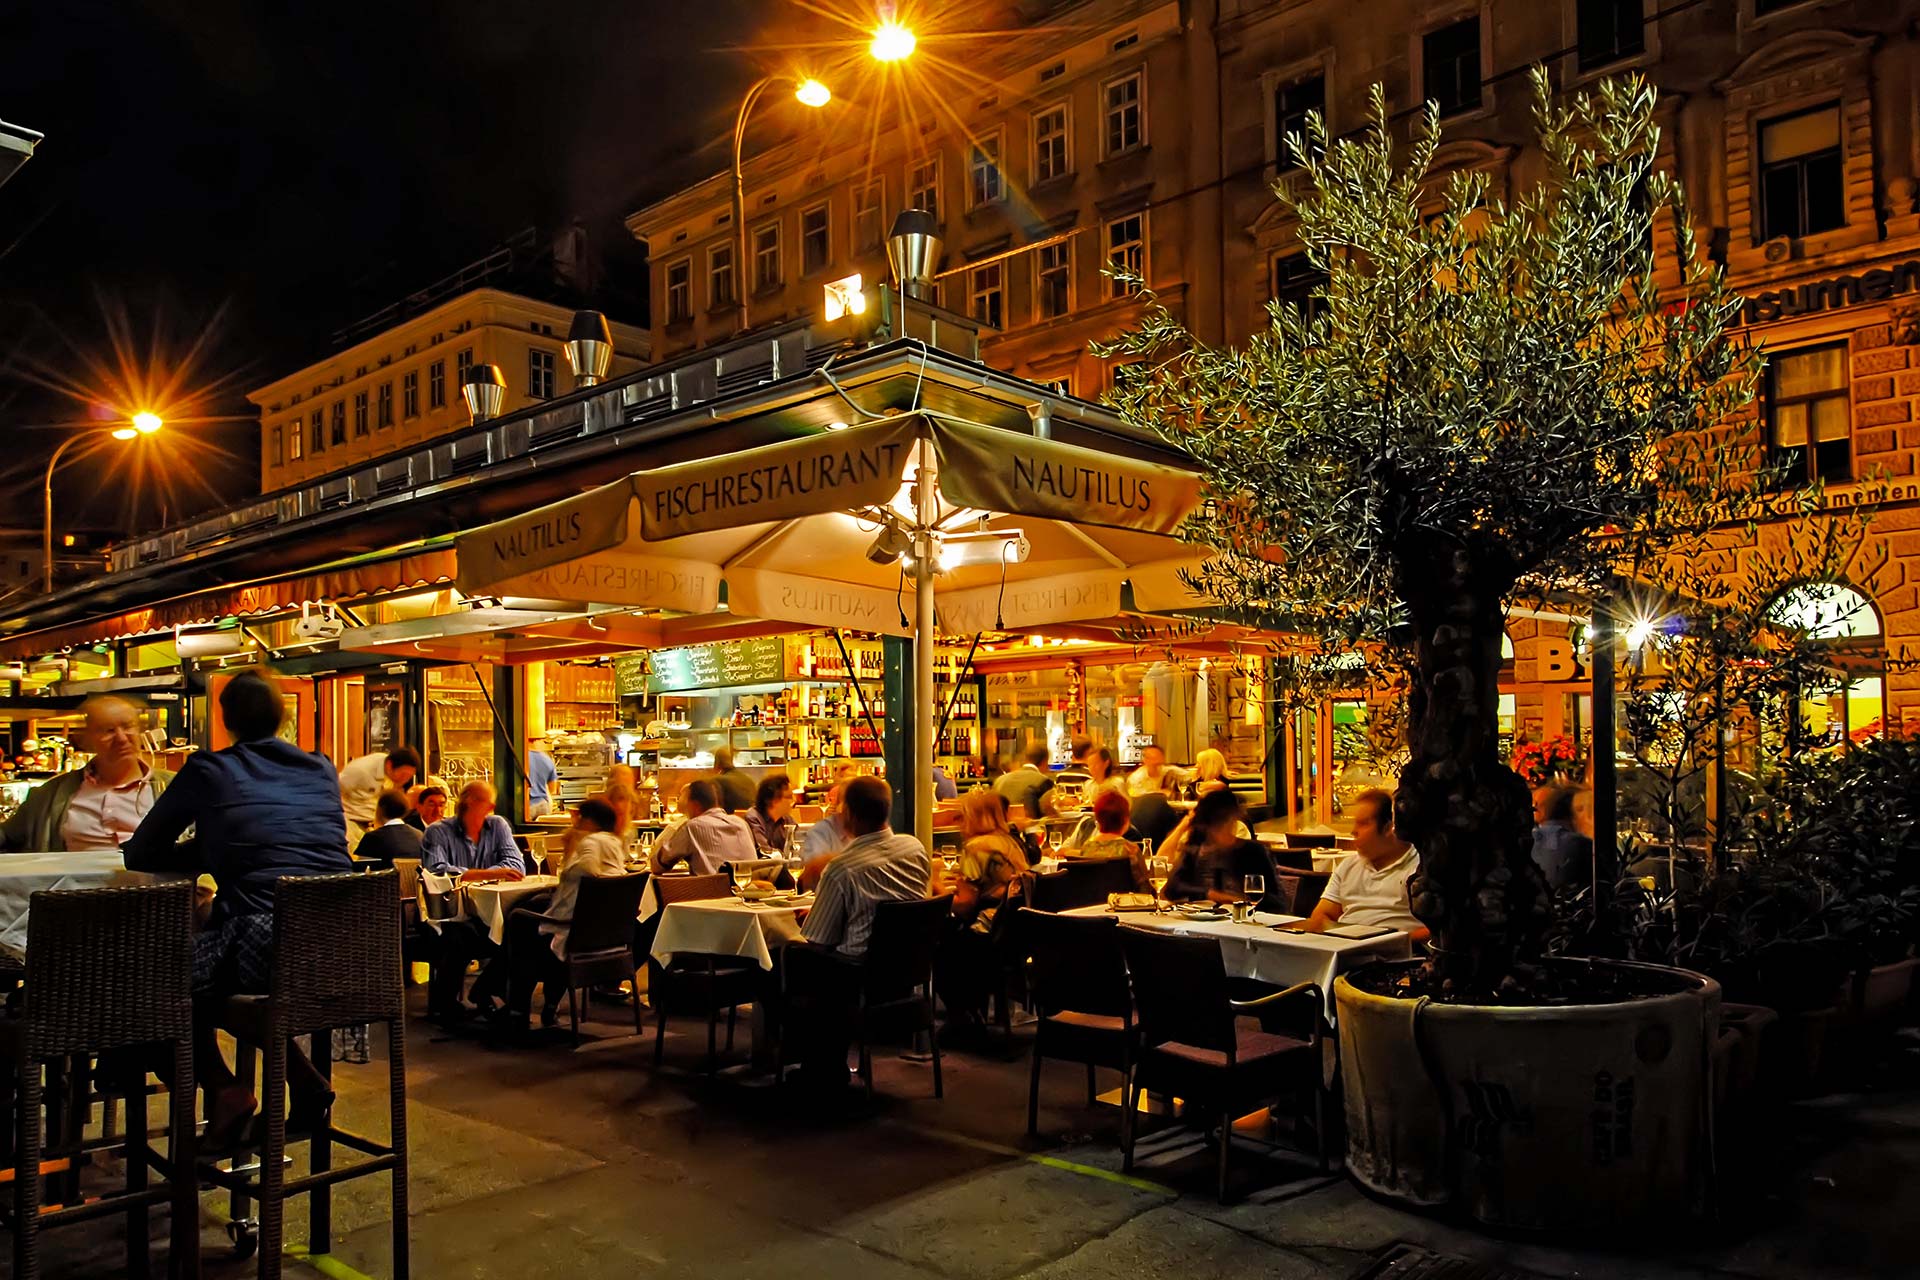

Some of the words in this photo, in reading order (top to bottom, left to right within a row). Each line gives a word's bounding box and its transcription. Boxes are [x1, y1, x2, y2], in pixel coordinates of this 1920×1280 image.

[1719, 260, 1920, 327] nsumen
[655, 444, 900, 521] FISCHRESTAURANT
[1013, 455, 1152, 512] NAUTILUS
[495, 512, 581, 562] NAUTILUS
